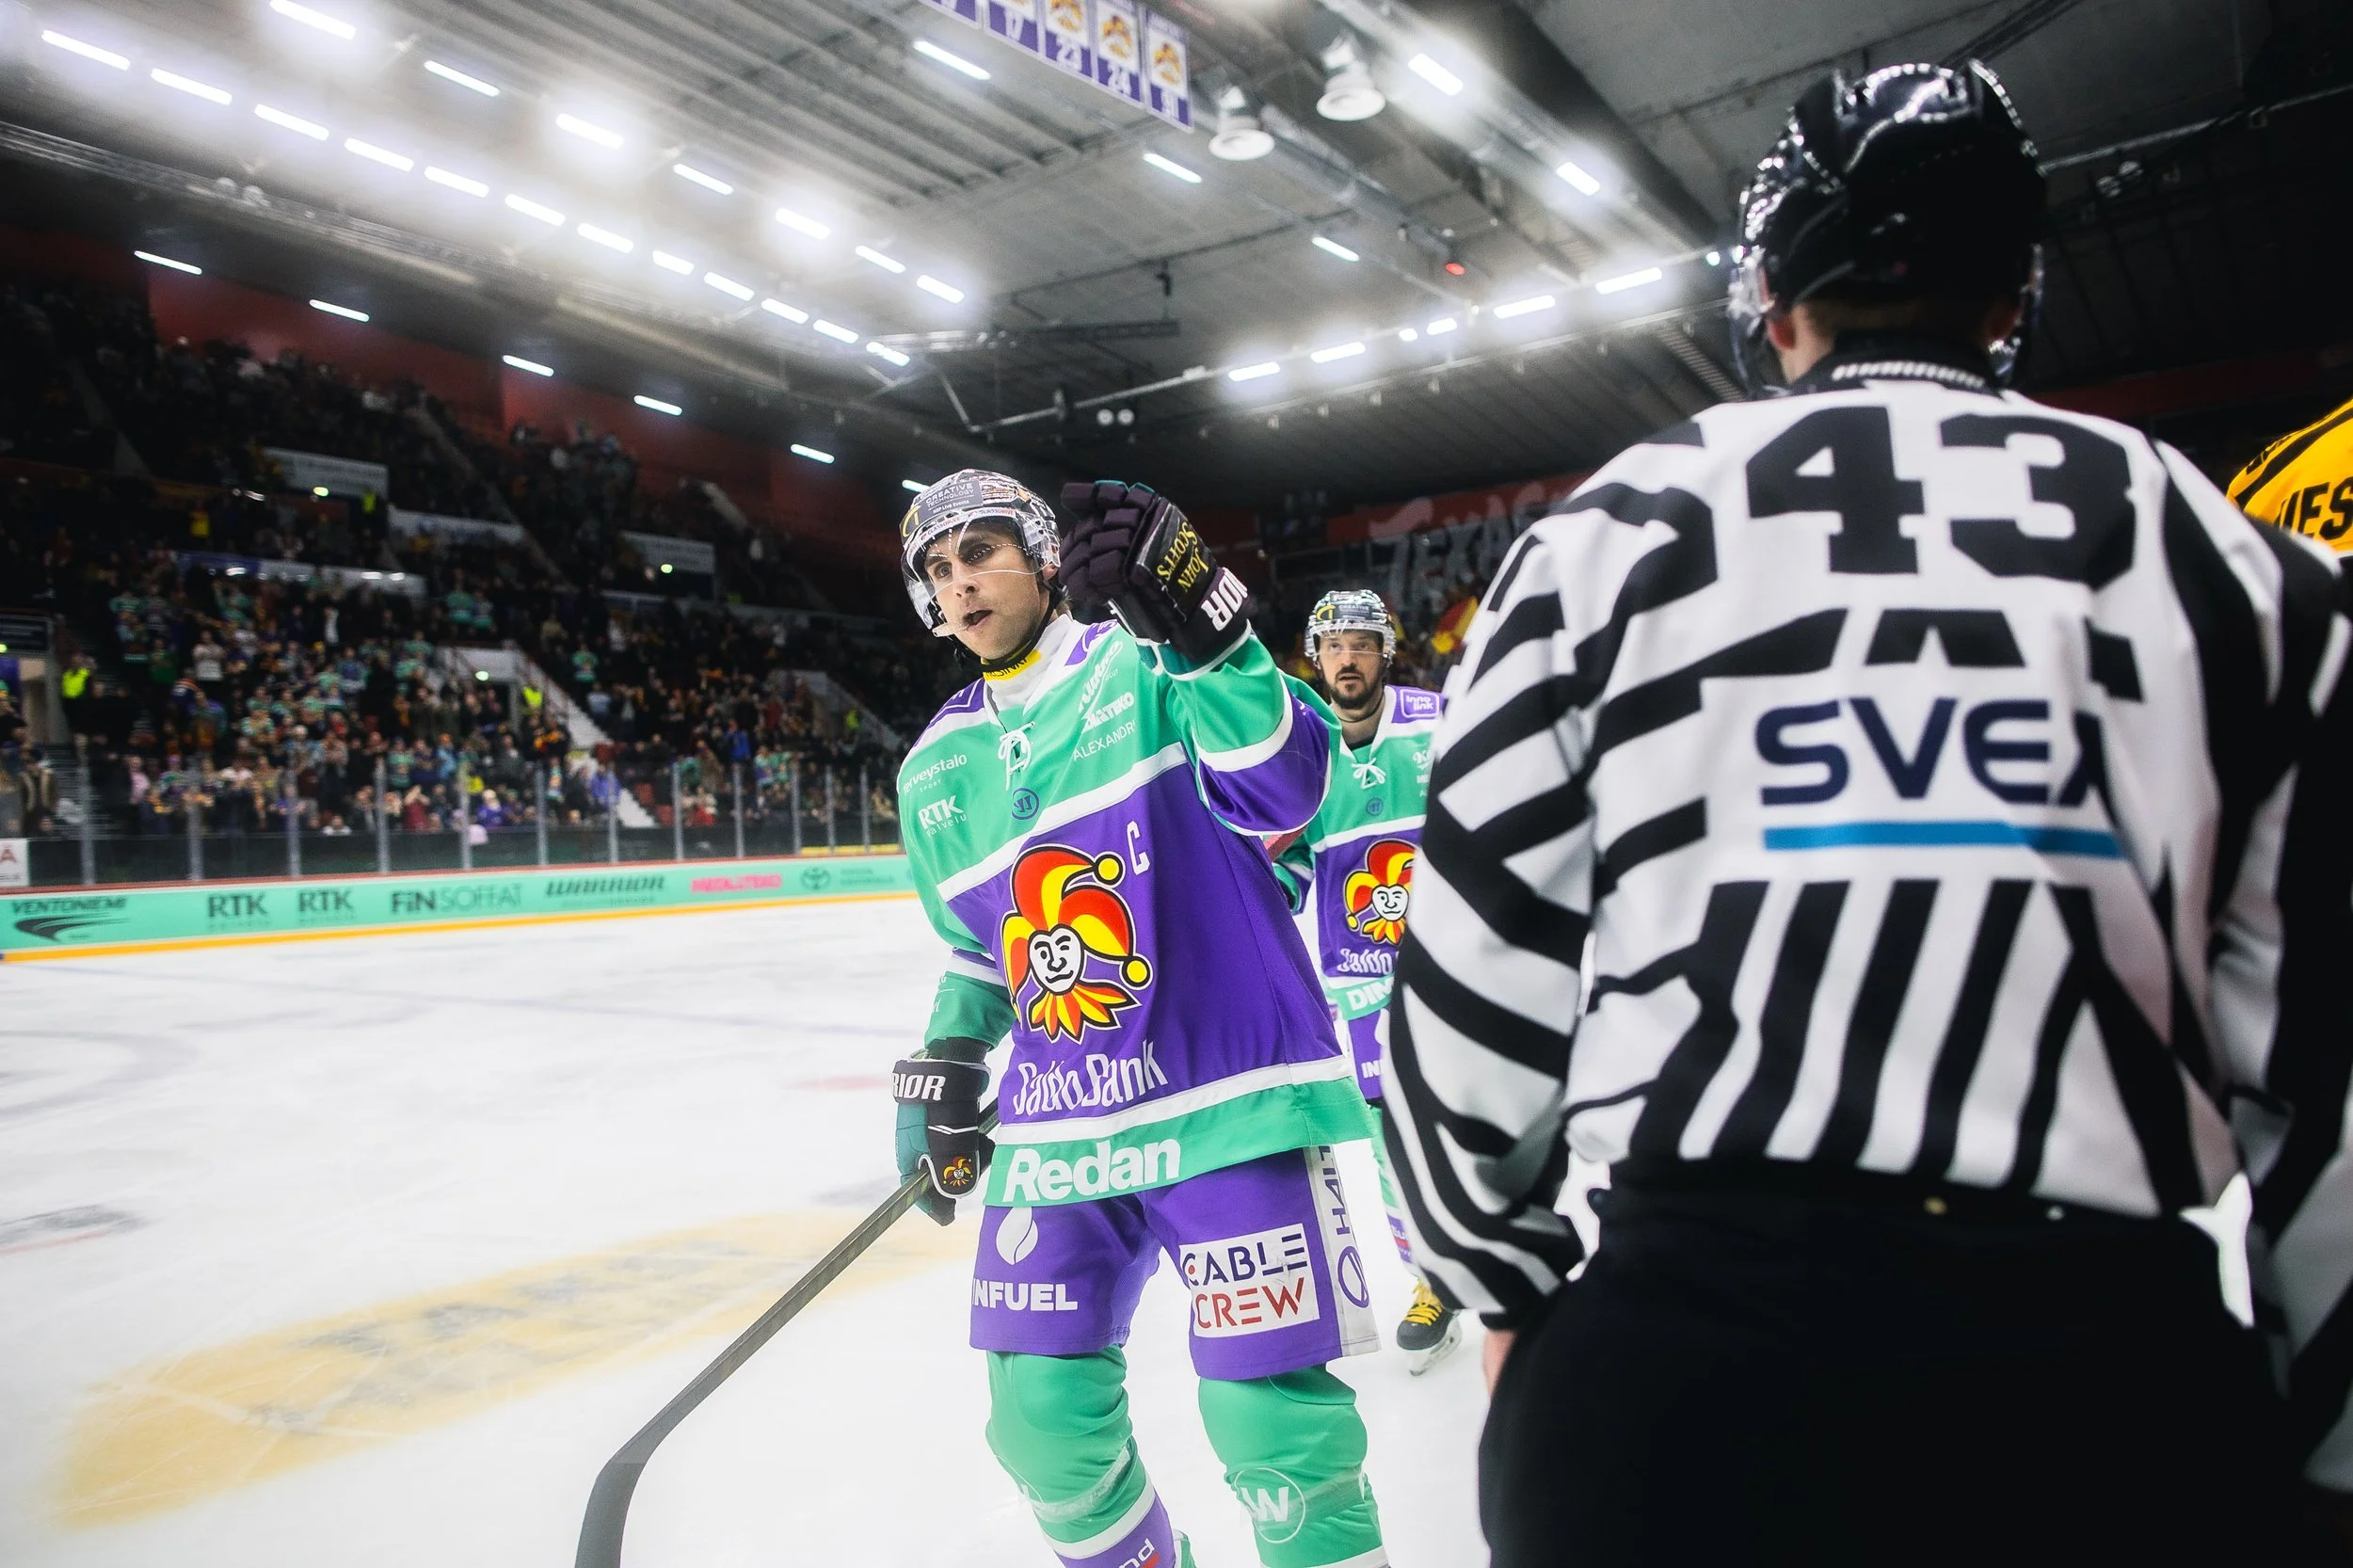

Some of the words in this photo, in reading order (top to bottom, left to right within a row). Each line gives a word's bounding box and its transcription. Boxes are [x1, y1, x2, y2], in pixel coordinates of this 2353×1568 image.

[926, 483, 973, 504] CREATIVE
[927, 489, 974, 508] TECHNOLOGY
[1745, 405, 2137, 593] 43
[2274, 476, 2353, 540] IES
[920, 778, 941, 793] SPORT
[919, 794, 965, 830] RTK
[1126, 820, 1150, 876] C
[207, 892, 268, 918] RTK
[297, 888, 355, 912] RTK
[1361, 1059, 1384, 1079] IN
[1002, 1138, 1182, 1203] Redan
[1182, 1232, 1308, 1288] CABLE
[1195, 1277, 1305, 1330] CREW
